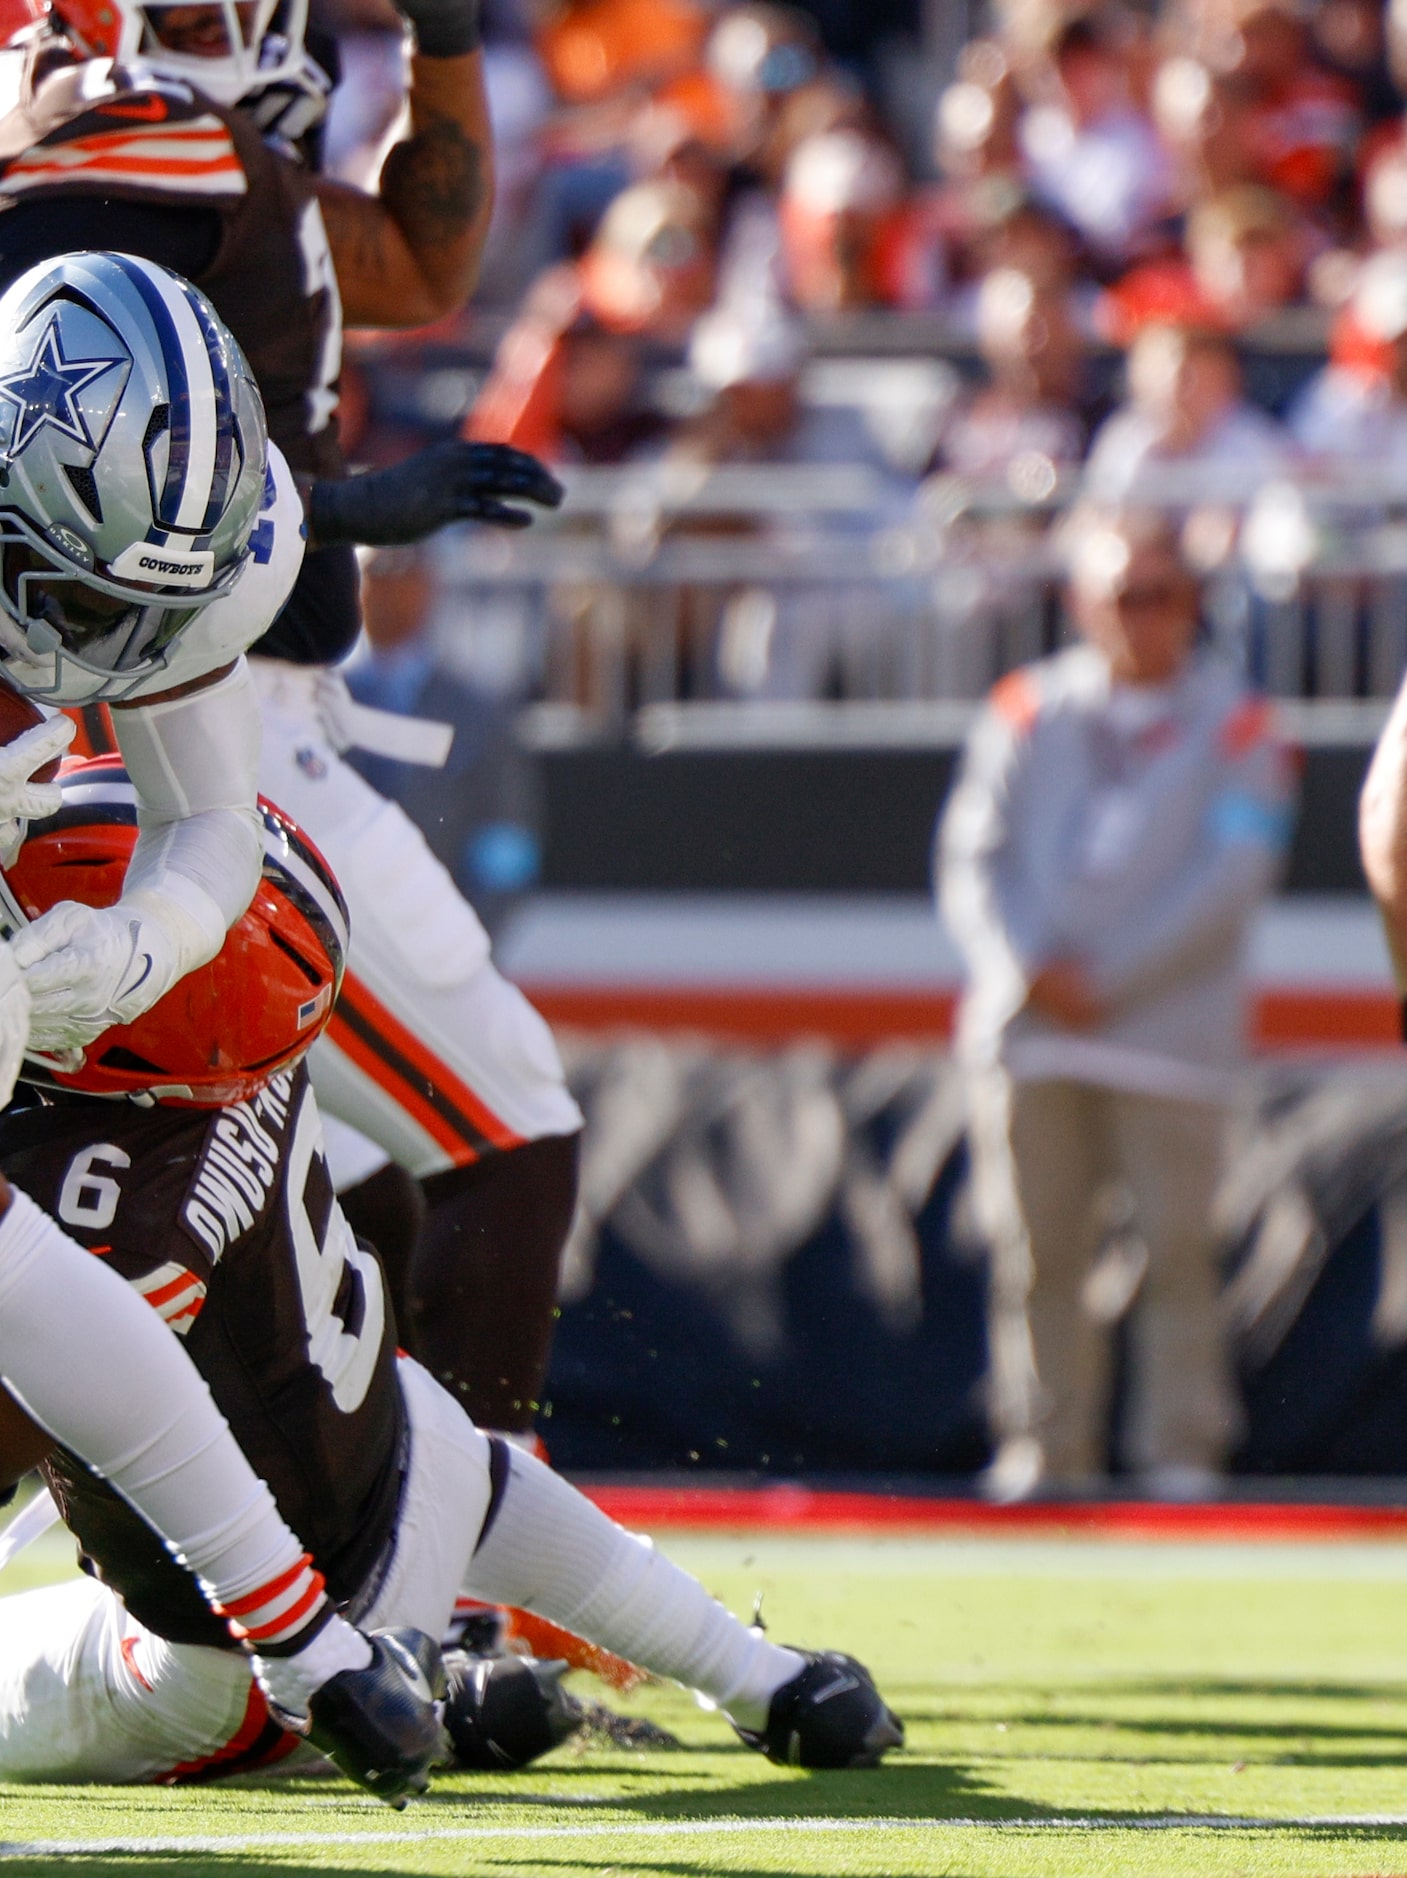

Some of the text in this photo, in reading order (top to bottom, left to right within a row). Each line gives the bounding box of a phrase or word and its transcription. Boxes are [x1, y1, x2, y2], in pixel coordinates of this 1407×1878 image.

[138, 556, 205, 576] COWBOYS
[57, 1142, 132, 1230] 6
[286, 1083, 386, 1414] 6
